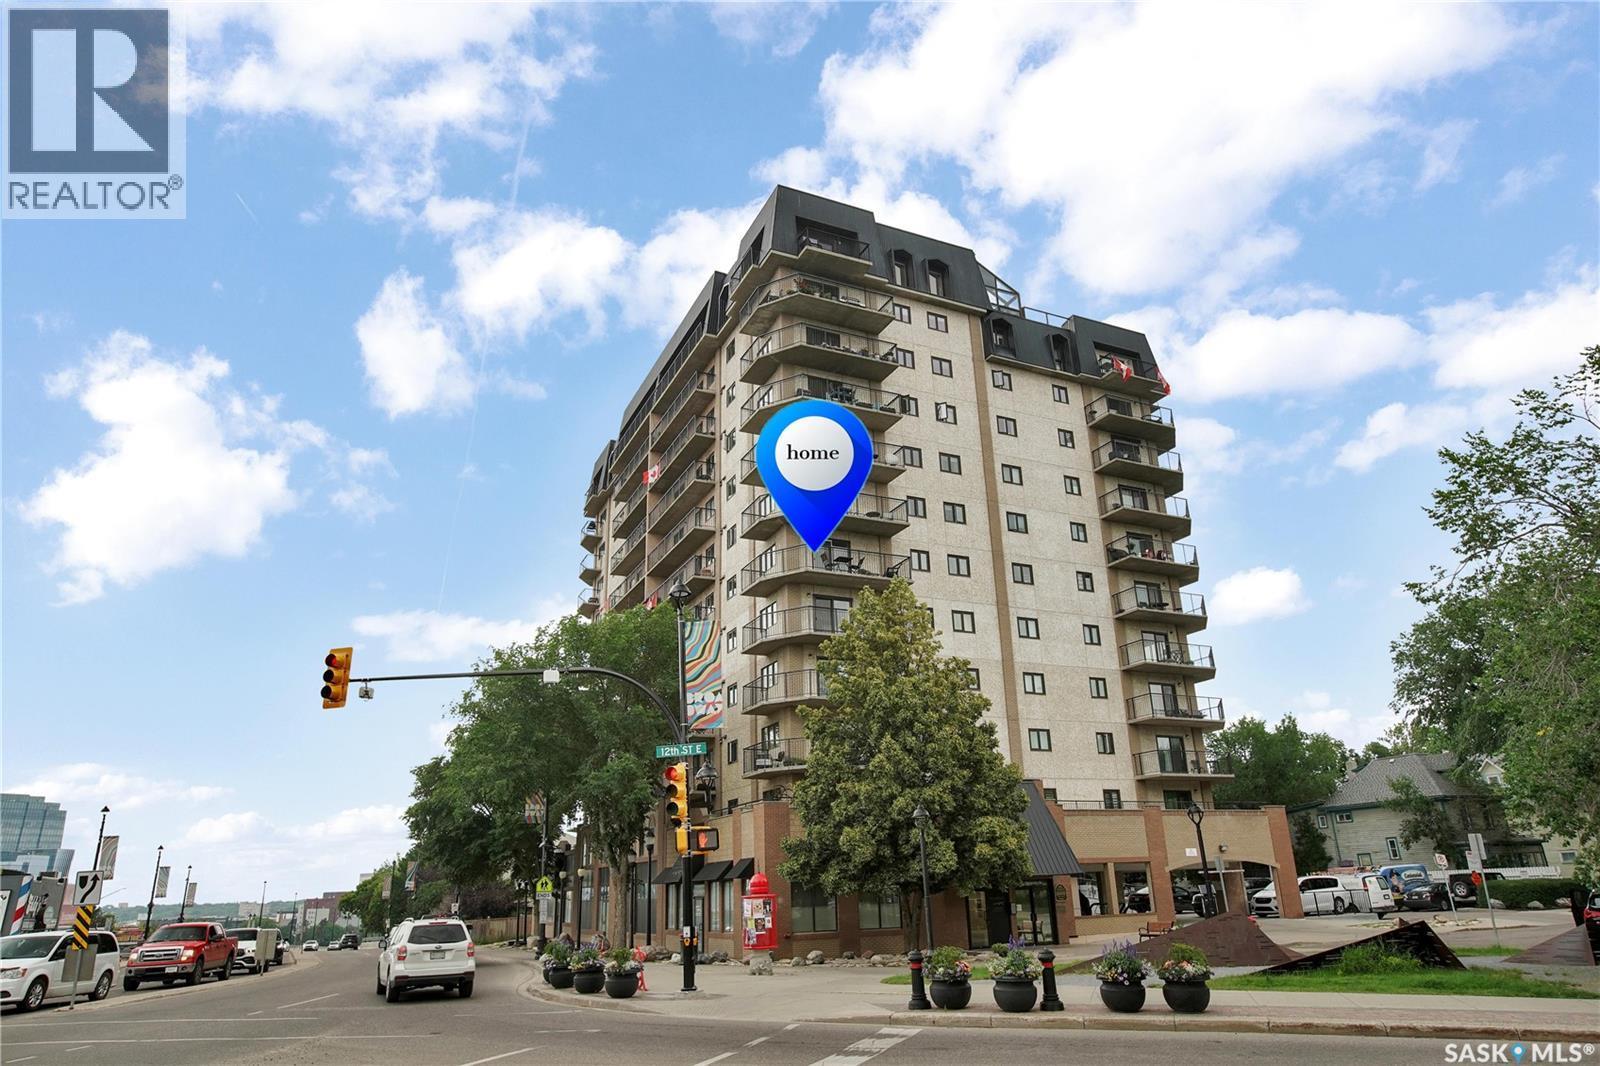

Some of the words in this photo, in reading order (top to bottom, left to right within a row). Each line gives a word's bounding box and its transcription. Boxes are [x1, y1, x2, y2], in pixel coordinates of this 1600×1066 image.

[661, 746, 680, 756] 12th
[681, 744, 693, 755] ST
[695, 744, 702, 753] E
